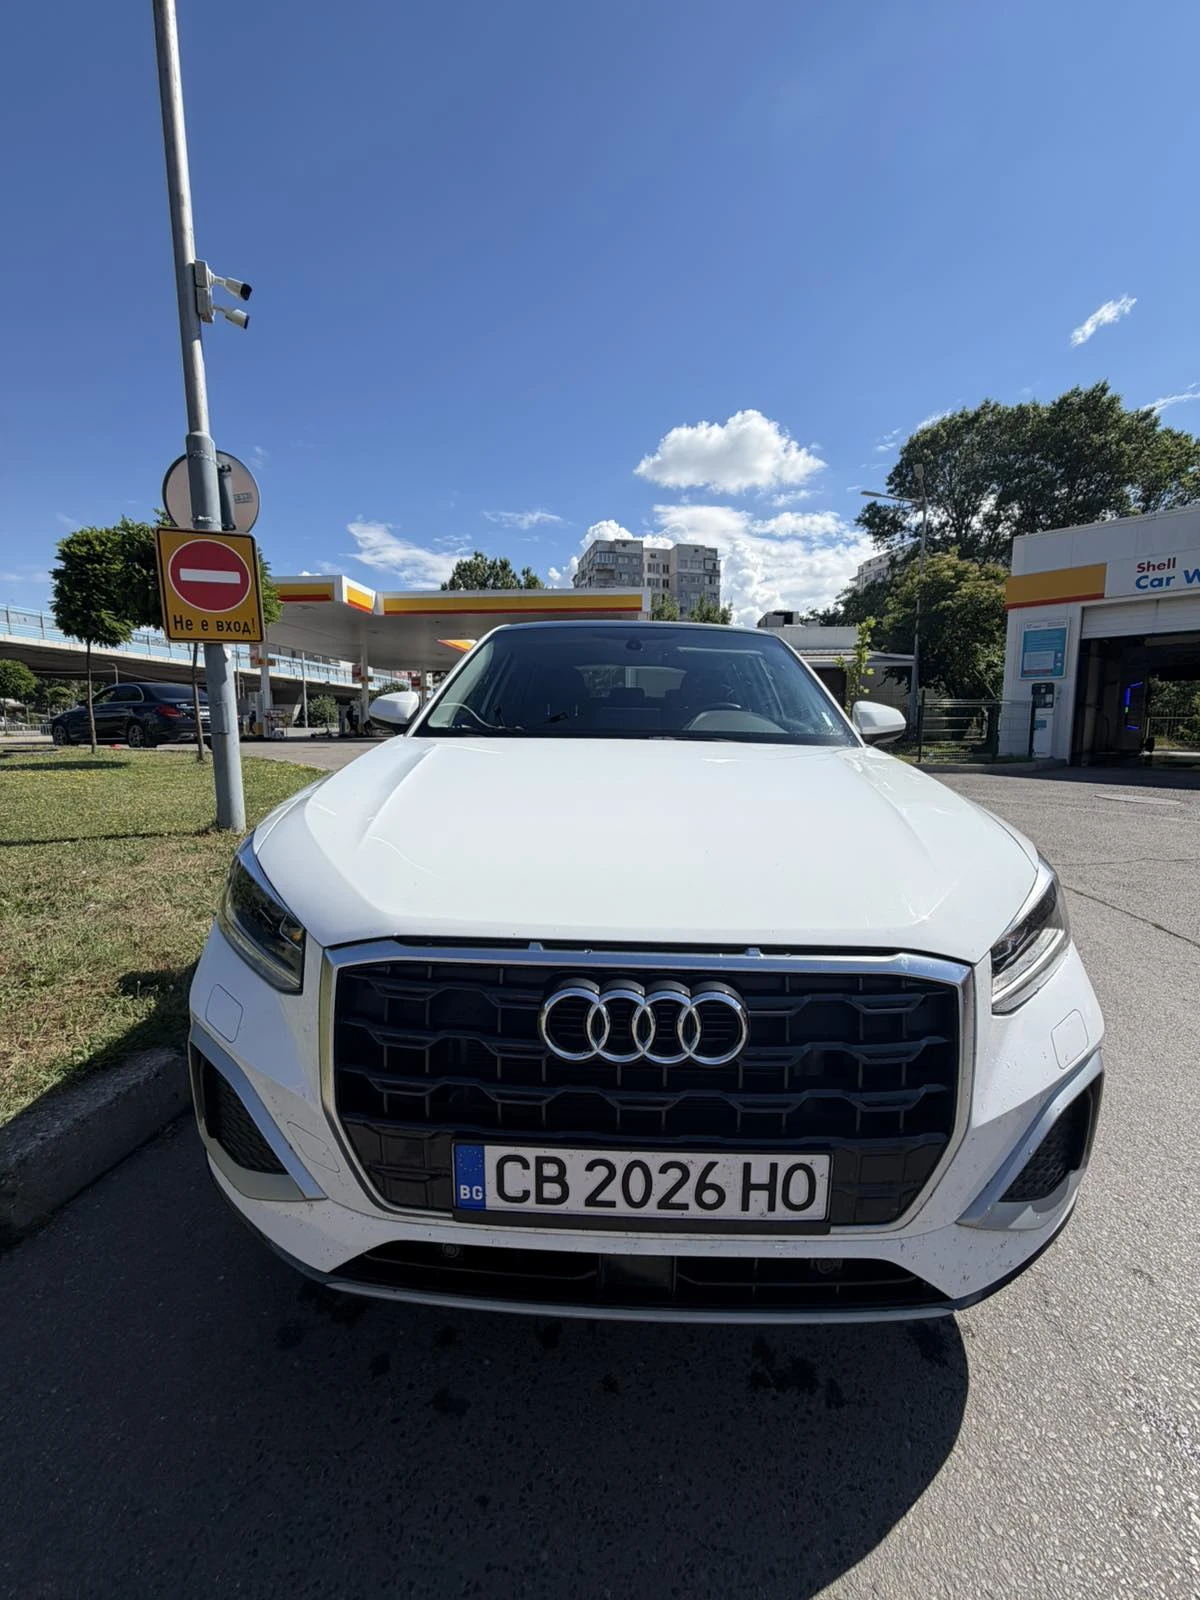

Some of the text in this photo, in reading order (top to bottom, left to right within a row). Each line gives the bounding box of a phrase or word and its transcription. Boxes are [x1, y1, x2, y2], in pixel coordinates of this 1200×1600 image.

[1136, 557, 1177, 574] Shell
[1135, 574, 1176, 590] Car
[173, 614, 256, 635] Не е вход!
[495, 1153, 817, 1213] CB 2026 HO
[459, 1184, 483, 1201] BG
